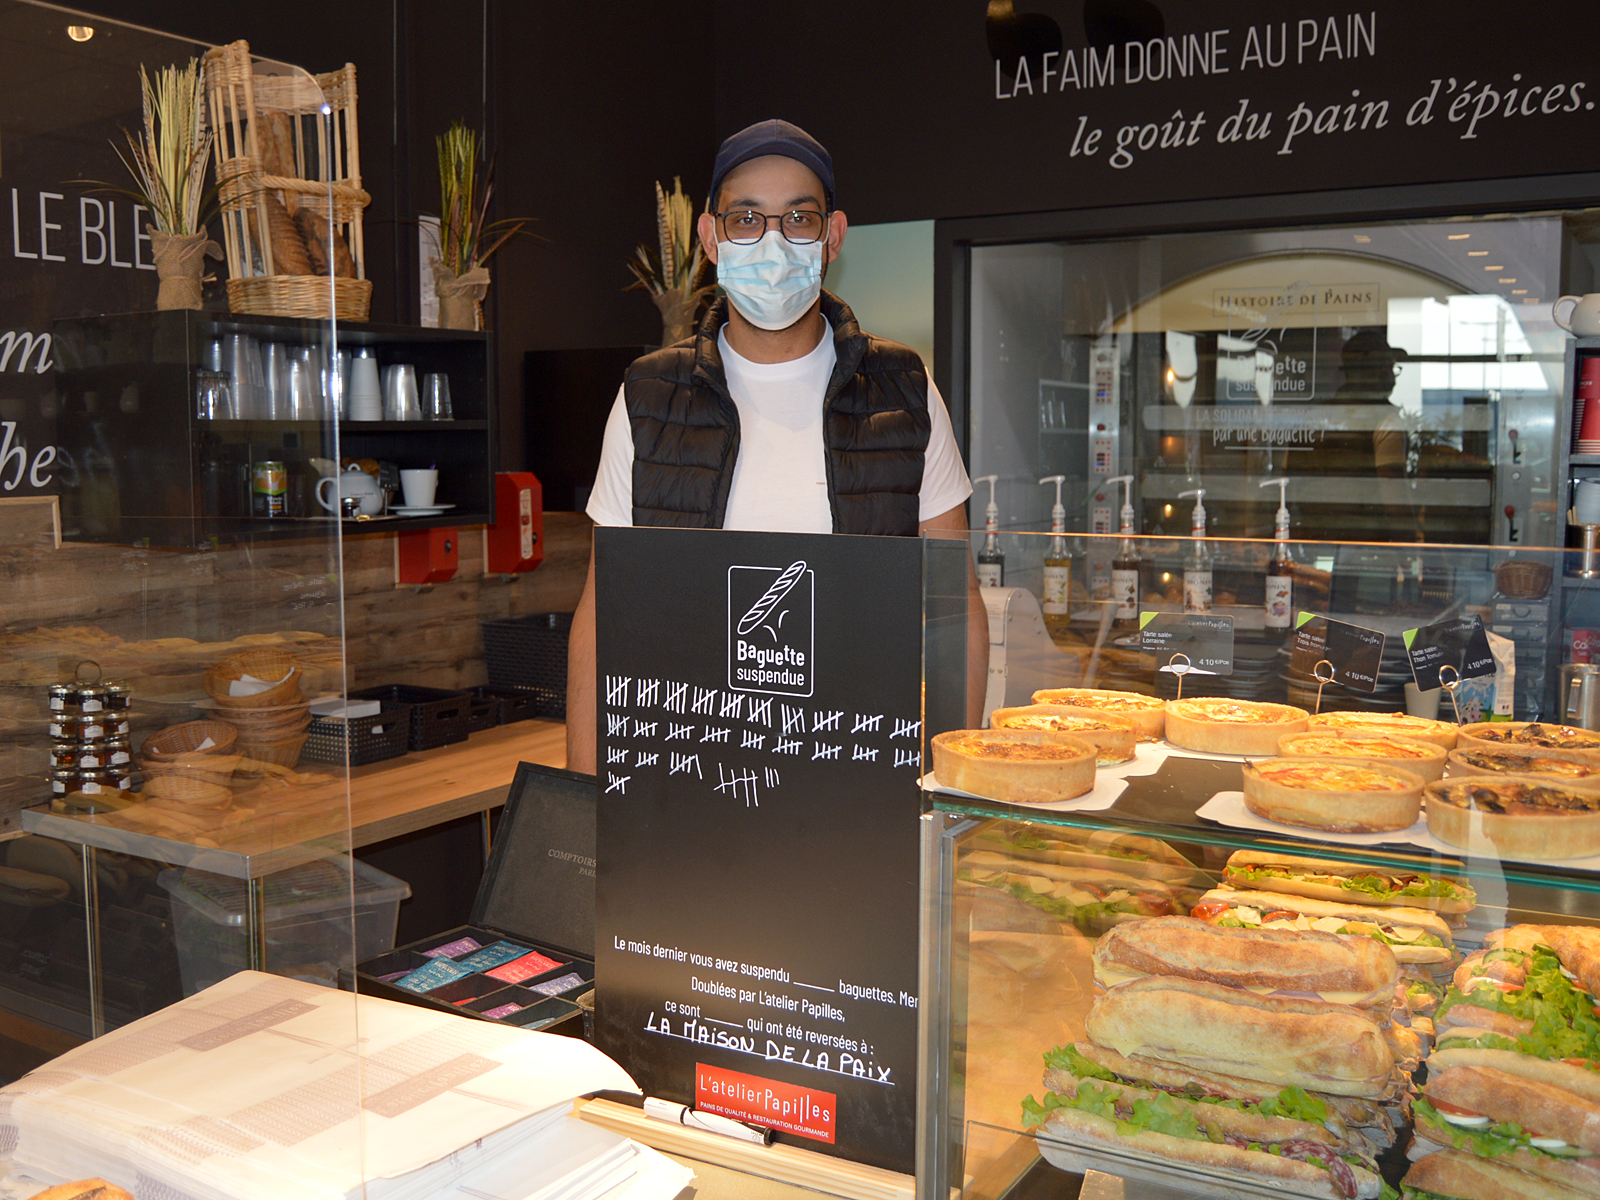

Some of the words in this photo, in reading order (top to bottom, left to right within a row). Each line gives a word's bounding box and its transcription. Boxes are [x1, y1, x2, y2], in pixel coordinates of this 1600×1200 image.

[996, 56, 1033, 99] LA
[1043, 45, 1115, 94] FAIM
[1125, 29, 1230, 84] DONNE
[1240, 23, 1286, 71] AU
[1298, 11, 1376, 65] PAIN
[1069, 116, 1103, 158] le
[1109, 109, 1207, 169] goût
[1216, 99, 1273, 144] du
[1277, 89, 1390, 155] pain
[1405, 73, 1596, 140] d'épices.
[12, 188, 66, 262] LE
[1324, 290, 1372, 305] PAINS
[1213, 427, 1233, 446] par
[1142, 637, 1166, 645] Lorraine
[1298, 631, 1311, 640] Tarte
[737, 640, 805, 669] Baguette
[1411, 649, 1424, 657] Tarte
[1413, 655, 1427, 664] Thon
[736, 667, 805, 686] suspendue
[548, 848, 597, 868] COMPTOIRS
[579, 867, 597, 878] PARI
[614, 935, 626, 951] Le
[628, 940, 651, 956] mois
[653, 943, 688, 962] dernier
[690, 952, 714, 968] vous
[715, 957, 738, 973] avez
[740, 962, 790, 983] suspendu
[839, 979, 896, 1004] baguettes.
[691, 975, 737, 999] Doublées
[739, 989, 756, 1004] par
[759, 989, 799, 1012] L'atelier
[801, 998, 846, 1023] Papilles,
[664, 1000, 677, 1013] ce
[679, 1003, 701, 1018] sont
[747, 1017, 763, 1033] qui
[766, 1021, 783, 1036] ont
[785, 1023, 803, 1040] été
[805, 1030, 858, 1052] reversées
[860, 1038, 868, 1054] à
[647, 1011, 671, 1036] LA
[765, 1039, 796, 1062] DE
[801, 1048, 830, 1070] LA
[700, 1101, 716, 1111] PAINS
[716, 1104, 724, 1113] DE
[724, 1107, 747, 1119] QUALITÉ
[752, 1114, 793, 1130] RESTAURATION
[793, 1123, 830, 1138] GOURMANDE
